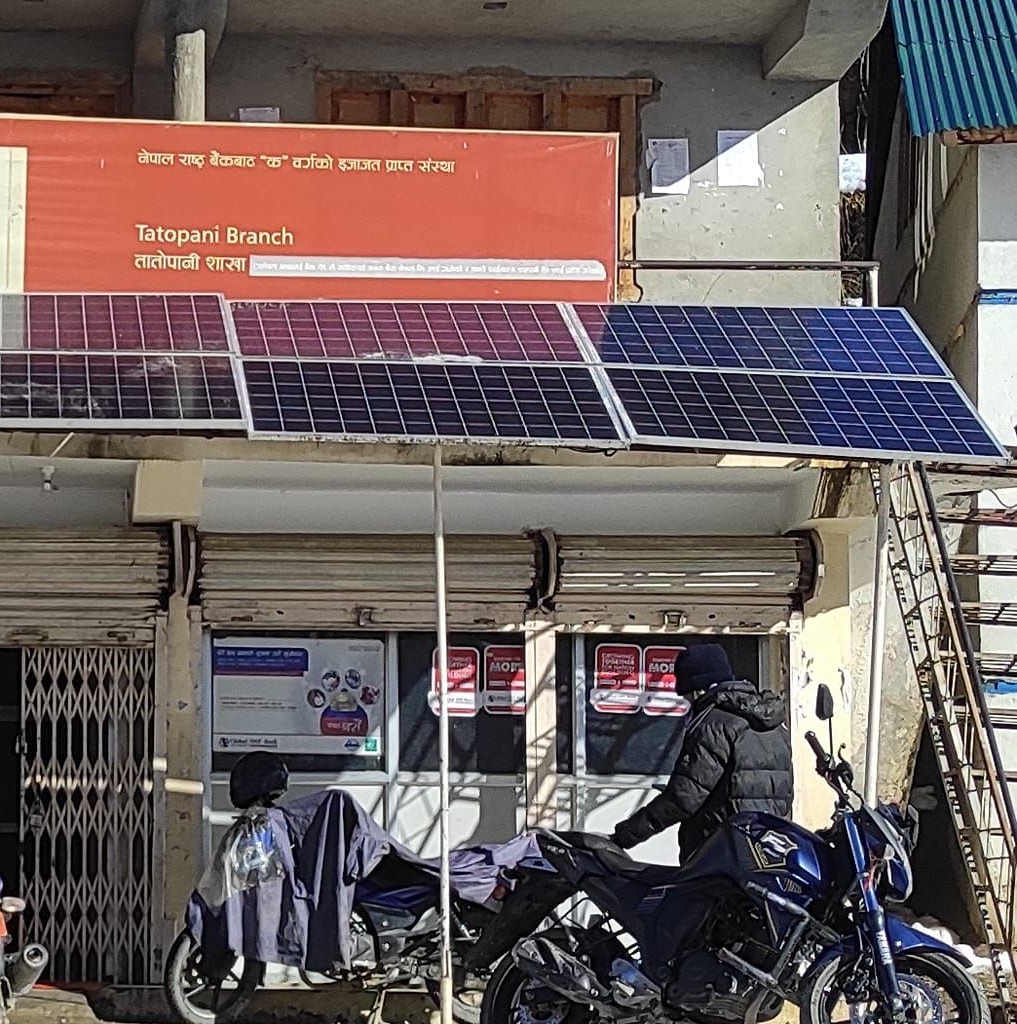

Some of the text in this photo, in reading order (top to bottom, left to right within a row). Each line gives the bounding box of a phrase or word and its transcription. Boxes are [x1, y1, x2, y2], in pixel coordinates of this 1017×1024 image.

[137, 148, 175, 165] नेपाल
[292, 154, 333, 170] वर्गको
[337, 157, 381, 172] इजाजत
[385, 159, 413, 172] प्राप्त
[417, 158, 455, 173] संस्था
[135, 224, 293, 247] Tatopani Branch
[134, 250, 201, 270] तातोपानी
[206, 256, 247, 272] शाखा
